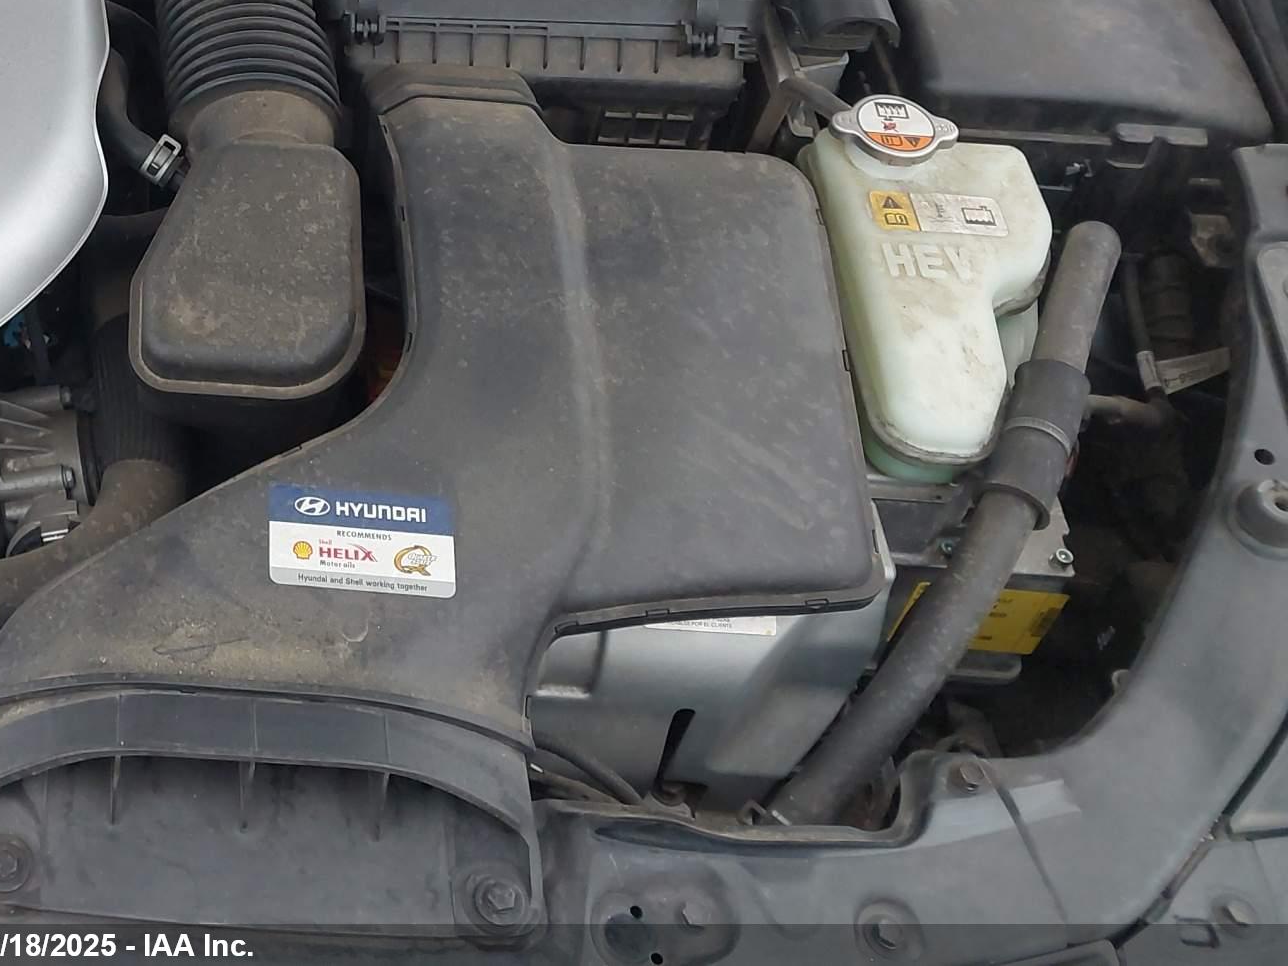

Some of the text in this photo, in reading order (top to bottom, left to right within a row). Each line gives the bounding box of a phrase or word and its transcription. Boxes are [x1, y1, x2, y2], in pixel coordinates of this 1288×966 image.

[881, 242, 974, 281] HEV
[336, 501, 427, 523] HYUNDAI
[336, 530, 392, 541] RECOMMENDS
[319, 545, 379, 563] HELIX
[319, 559, 342, 568] Motor
[298, 573, 428, 592] Hyundai and Shell working together
